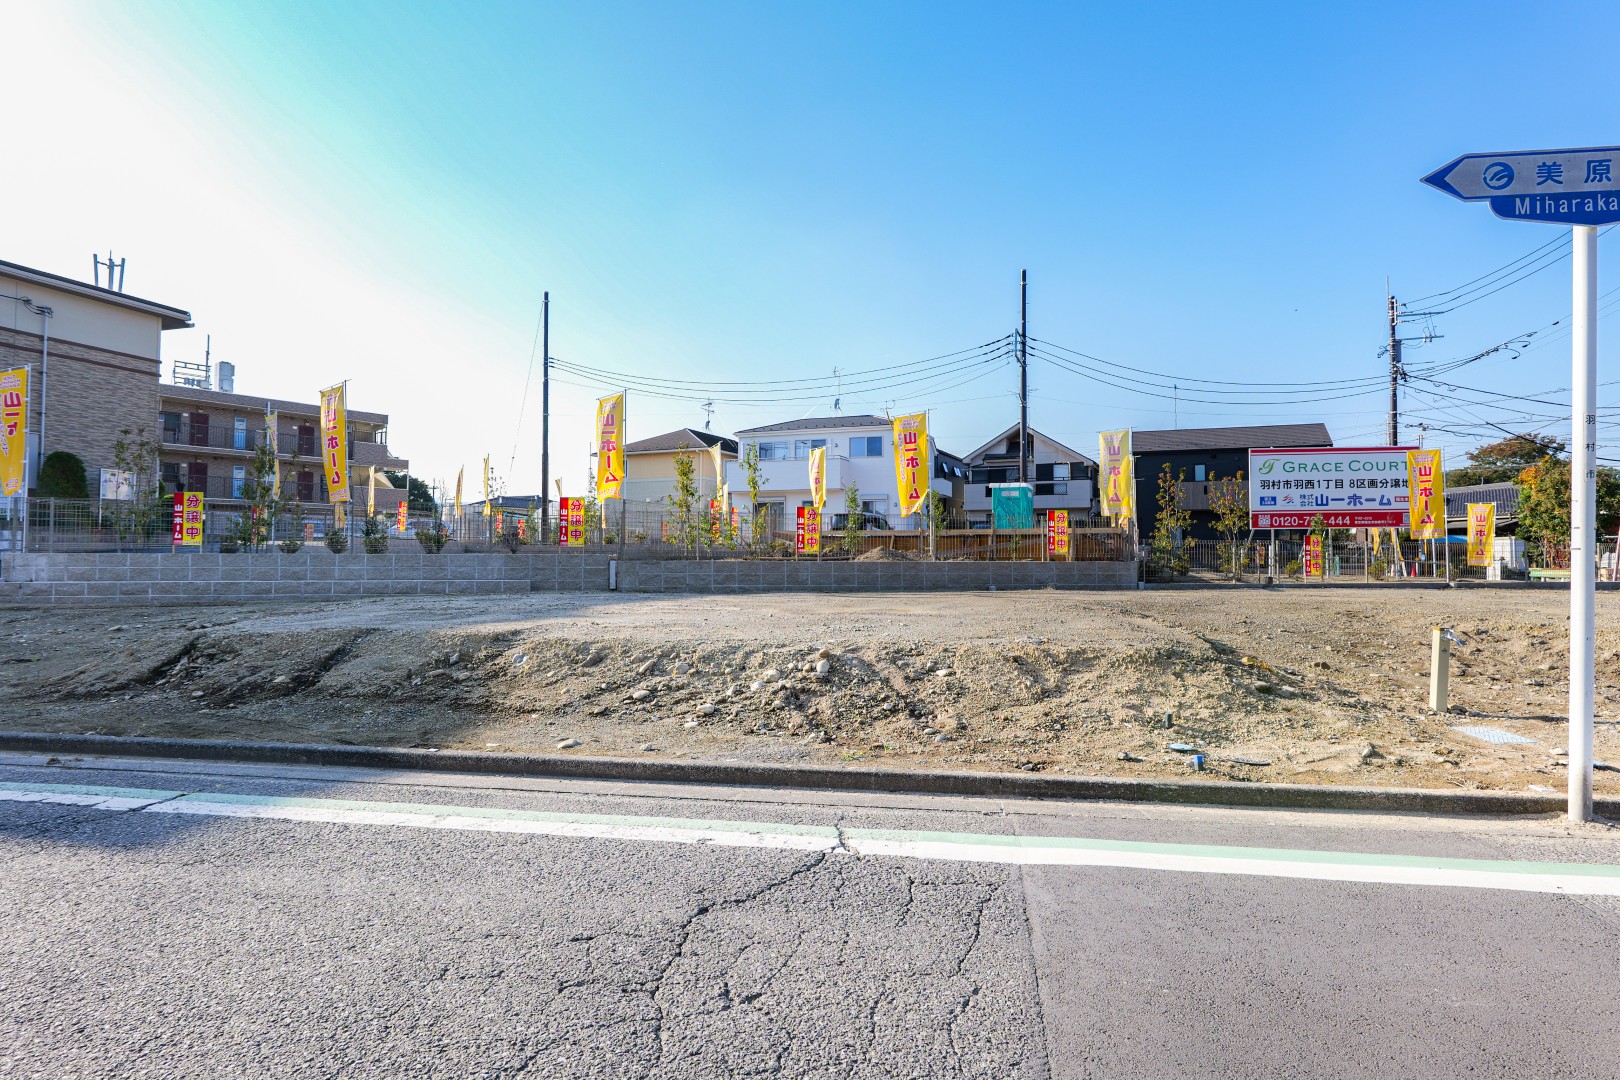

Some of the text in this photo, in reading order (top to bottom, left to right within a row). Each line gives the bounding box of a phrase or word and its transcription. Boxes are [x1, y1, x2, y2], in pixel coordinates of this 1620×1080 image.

[1536, 158, 1612, 187] 美原
[1515, 194, 1618, 216] Miharaka
[1585, 414, 1596, 479] 羽村市
[1282, 460, 1408, 473] GRACE COURT
[1259, 479, 1344, 490] 羽村市羽西1丁目
[1315, 493, 1392, 507] 山一ホーム
[174, 504, 183, 539] 山一ホーム
[185, 494, 202, 539] 分譲中
[560, 508, 568, 541] 山一ホーム
[570, 499, 583, 541] 分譲中
